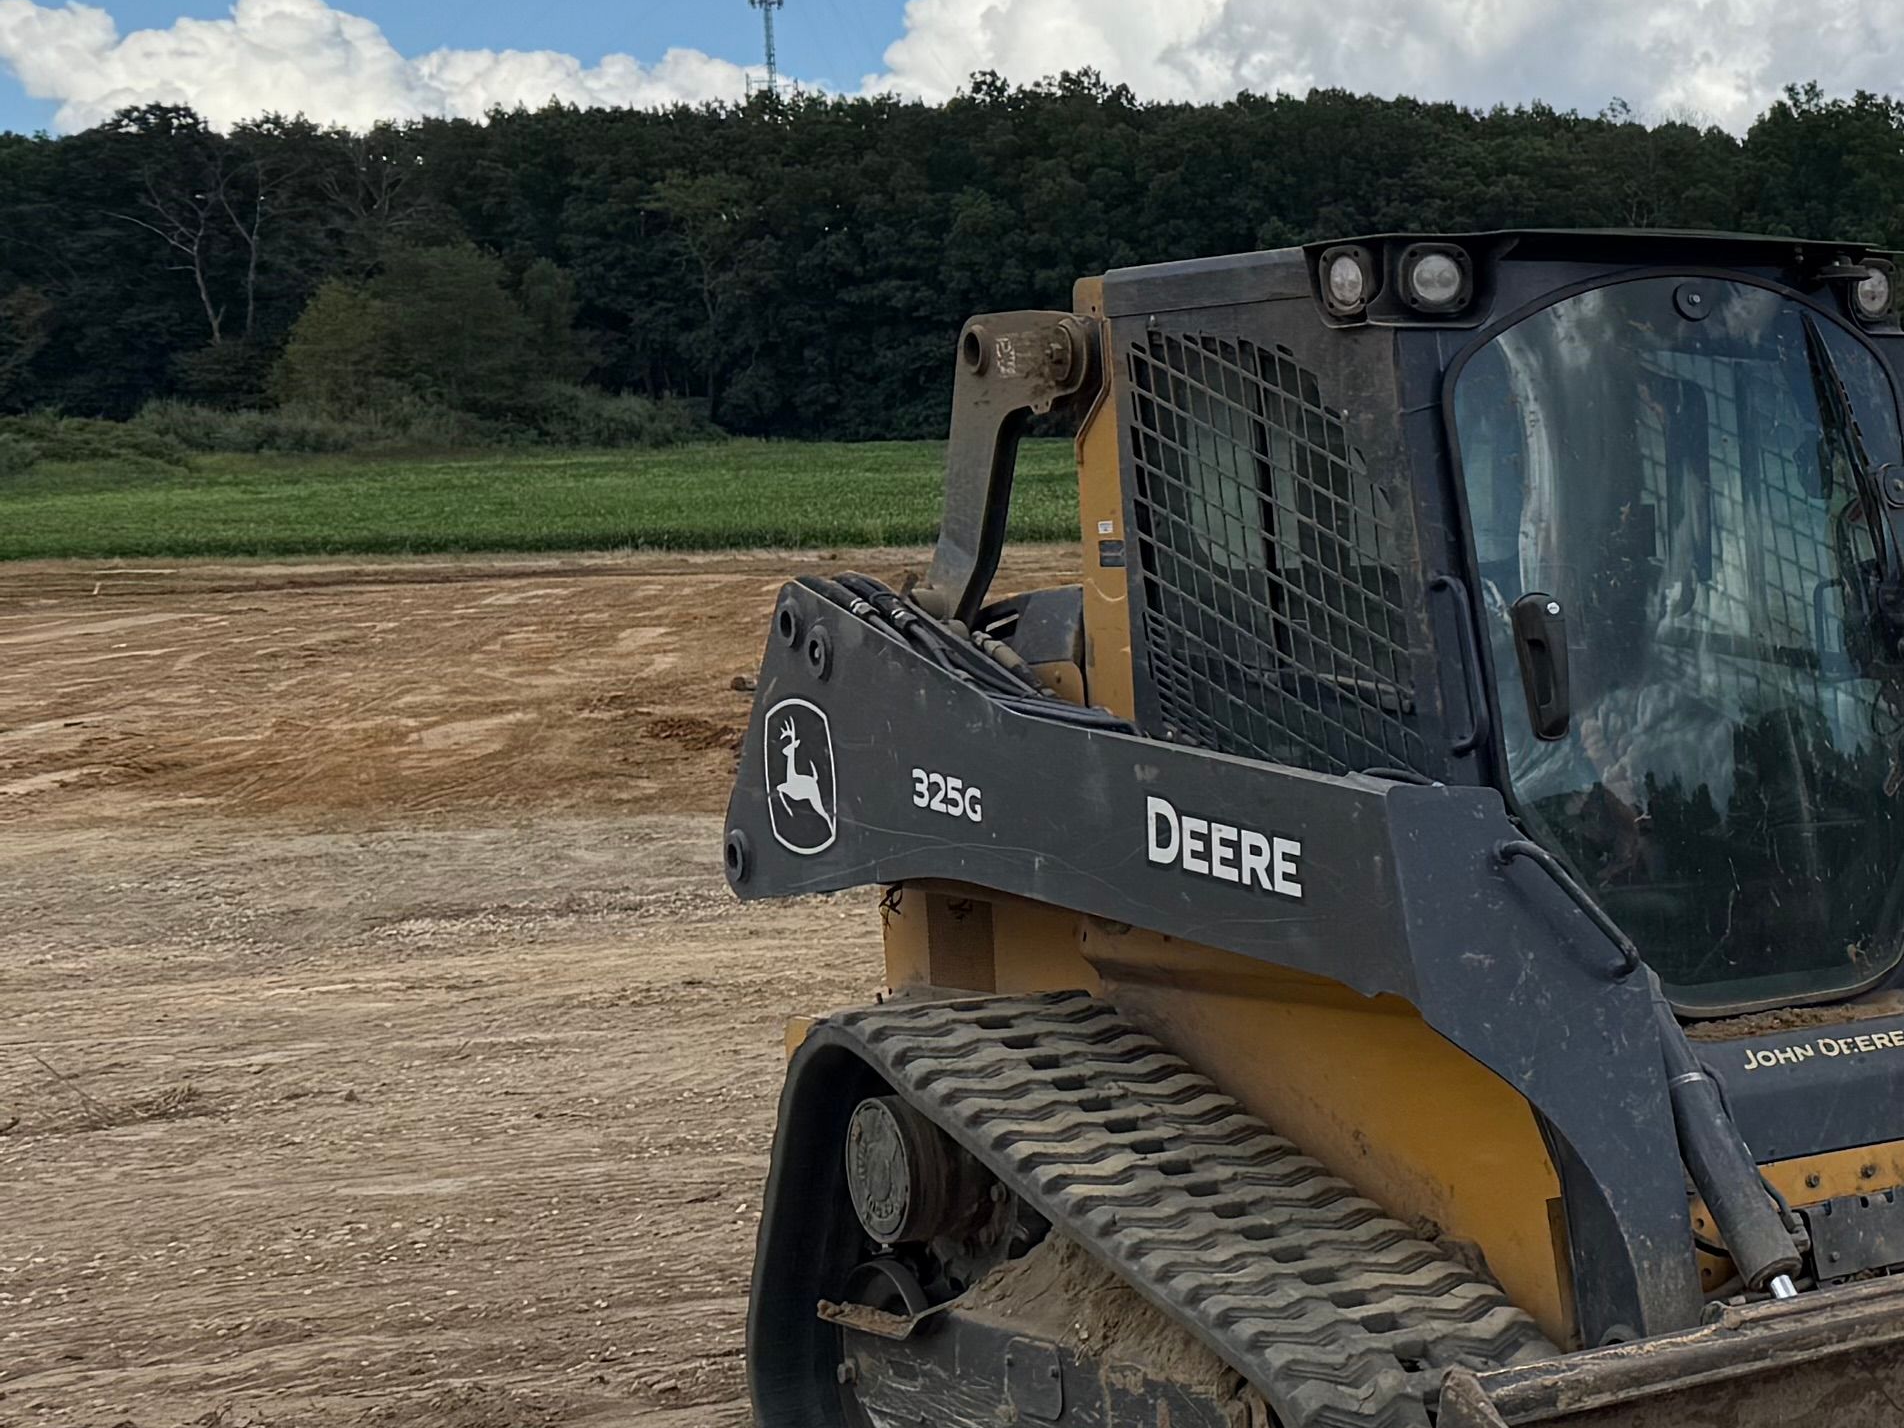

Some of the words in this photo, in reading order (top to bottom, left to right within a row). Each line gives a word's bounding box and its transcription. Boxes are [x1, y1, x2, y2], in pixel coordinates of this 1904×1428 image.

[912, 768, 982, 822] 325G
[1147, 796, 1302, 898] DEERE
[1744, 1044, 1814, 1070] JOHN
